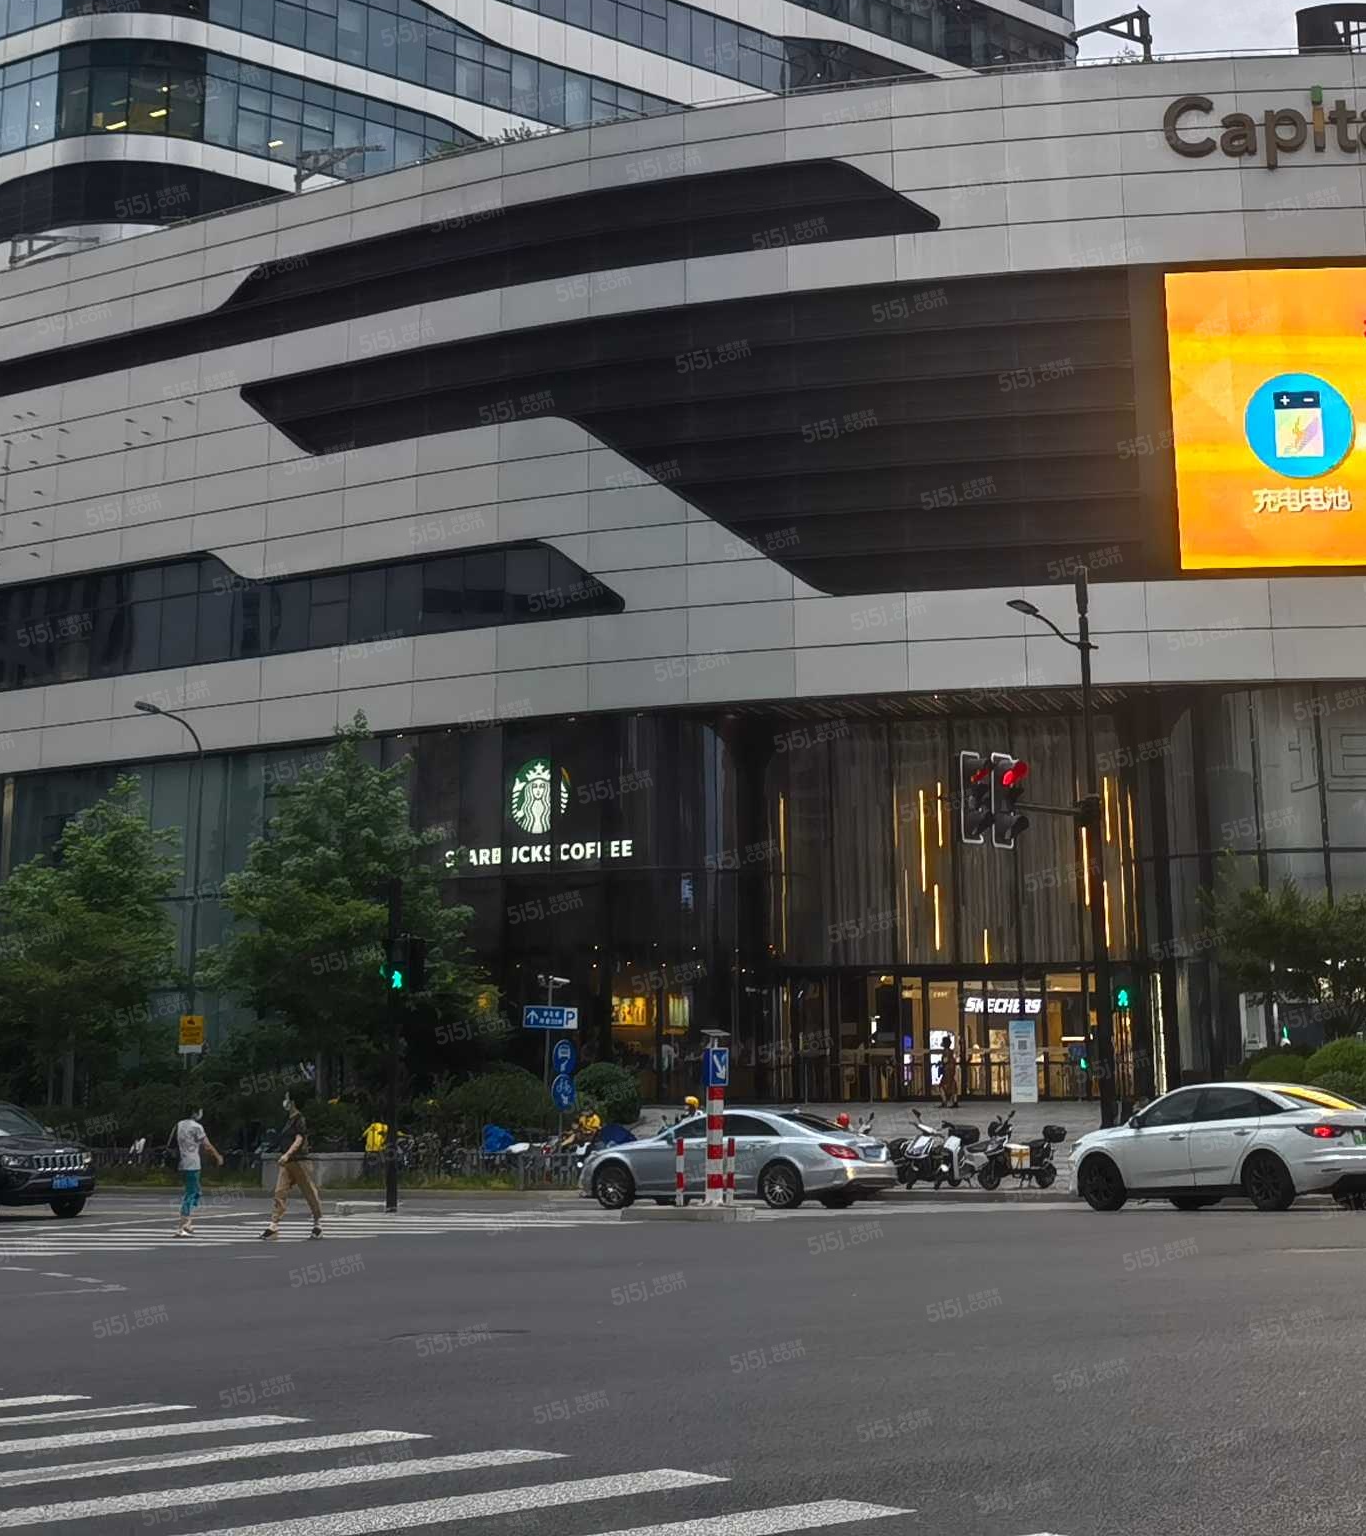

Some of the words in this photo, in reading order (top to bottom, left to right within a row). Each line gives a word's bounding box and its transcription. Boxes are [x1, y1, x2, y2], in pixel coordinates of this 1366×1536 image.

[1252, 485, 1352, 513] 充电电池
[566, 1011, 576, 1026] P
